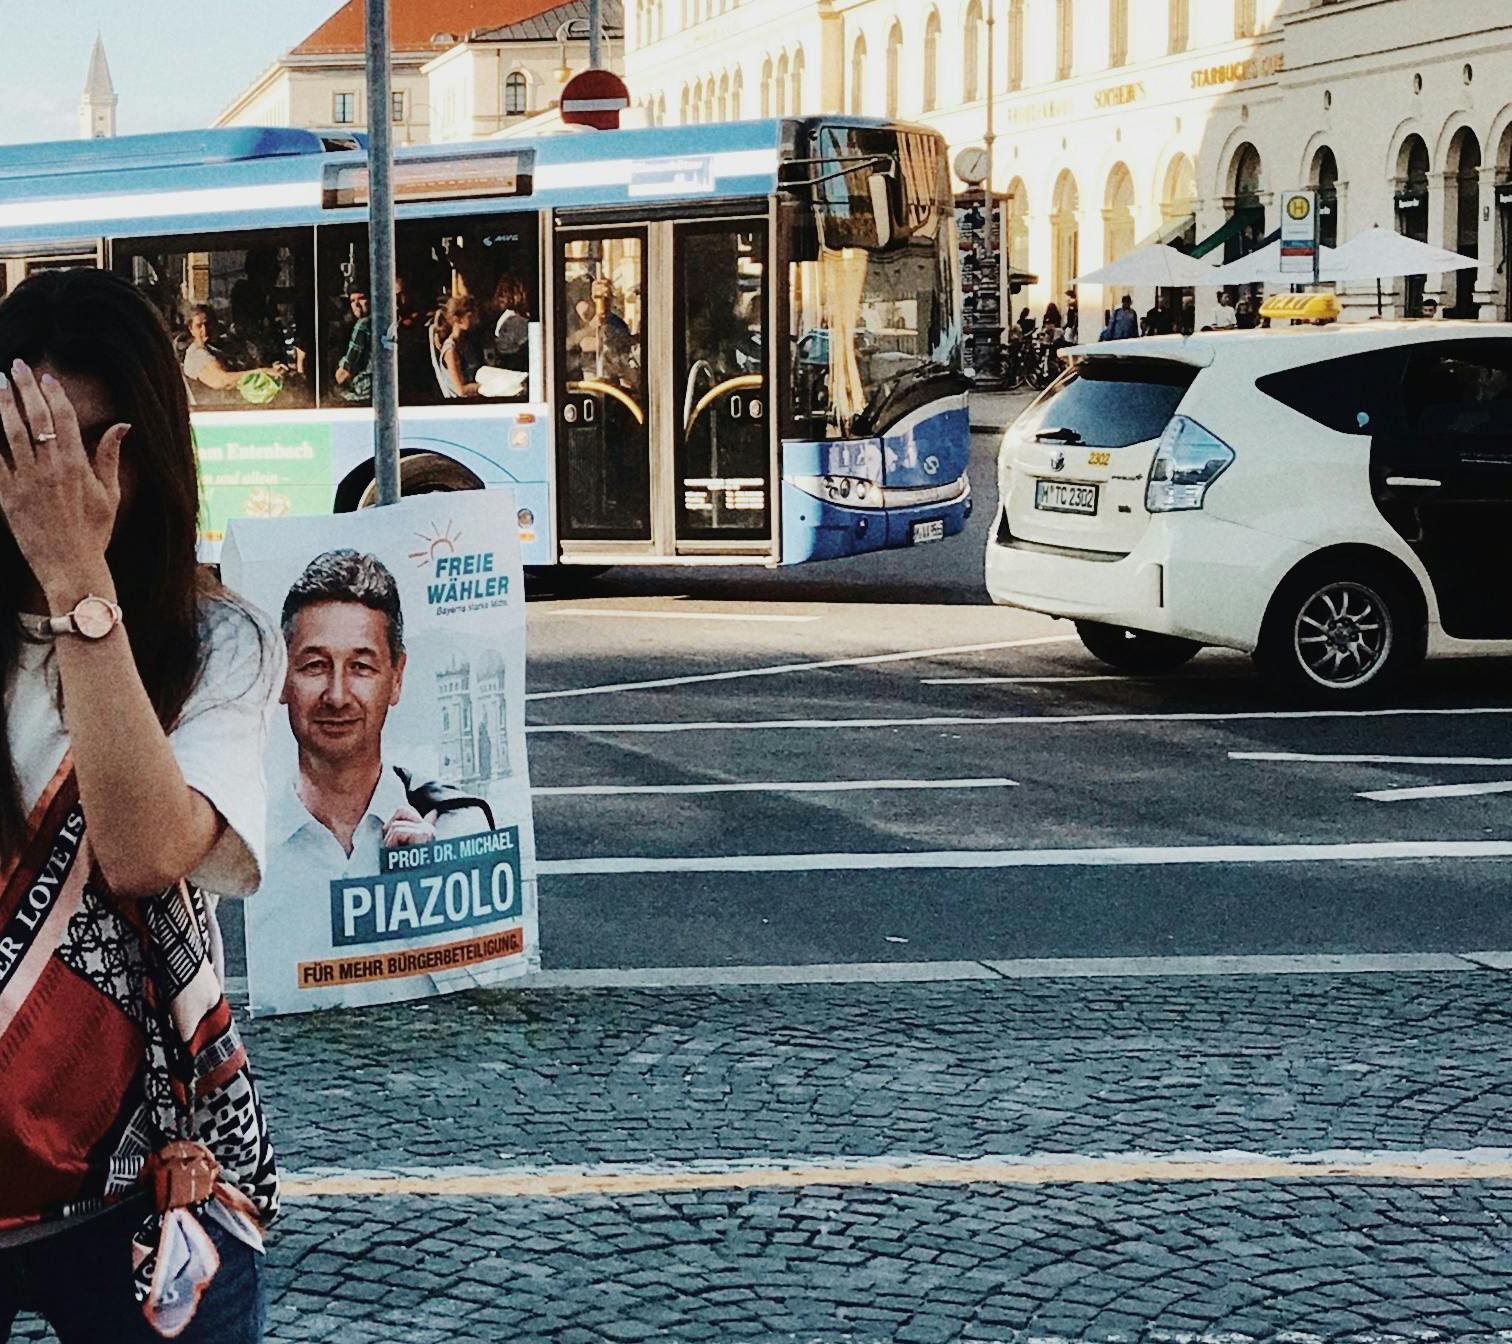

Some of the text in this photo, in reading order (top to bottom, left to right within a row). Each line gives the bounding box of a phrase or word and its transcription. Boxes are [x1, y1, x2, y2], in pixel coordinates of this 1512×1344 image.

[436, 553, 494, 578] FREIE
[427, 576, 510, 605] WÄHLER
[15, 846, 71, 930] LOVE
[58, 812, 85, 845] IS
[388, 831, 514, 870] PROF. DR. MICHAEL
[342, 862, 515, 937] PIAZOLO
[303, 934, 520, 984] FÜR MEHR BÜRGERBETEILIGUNG.
